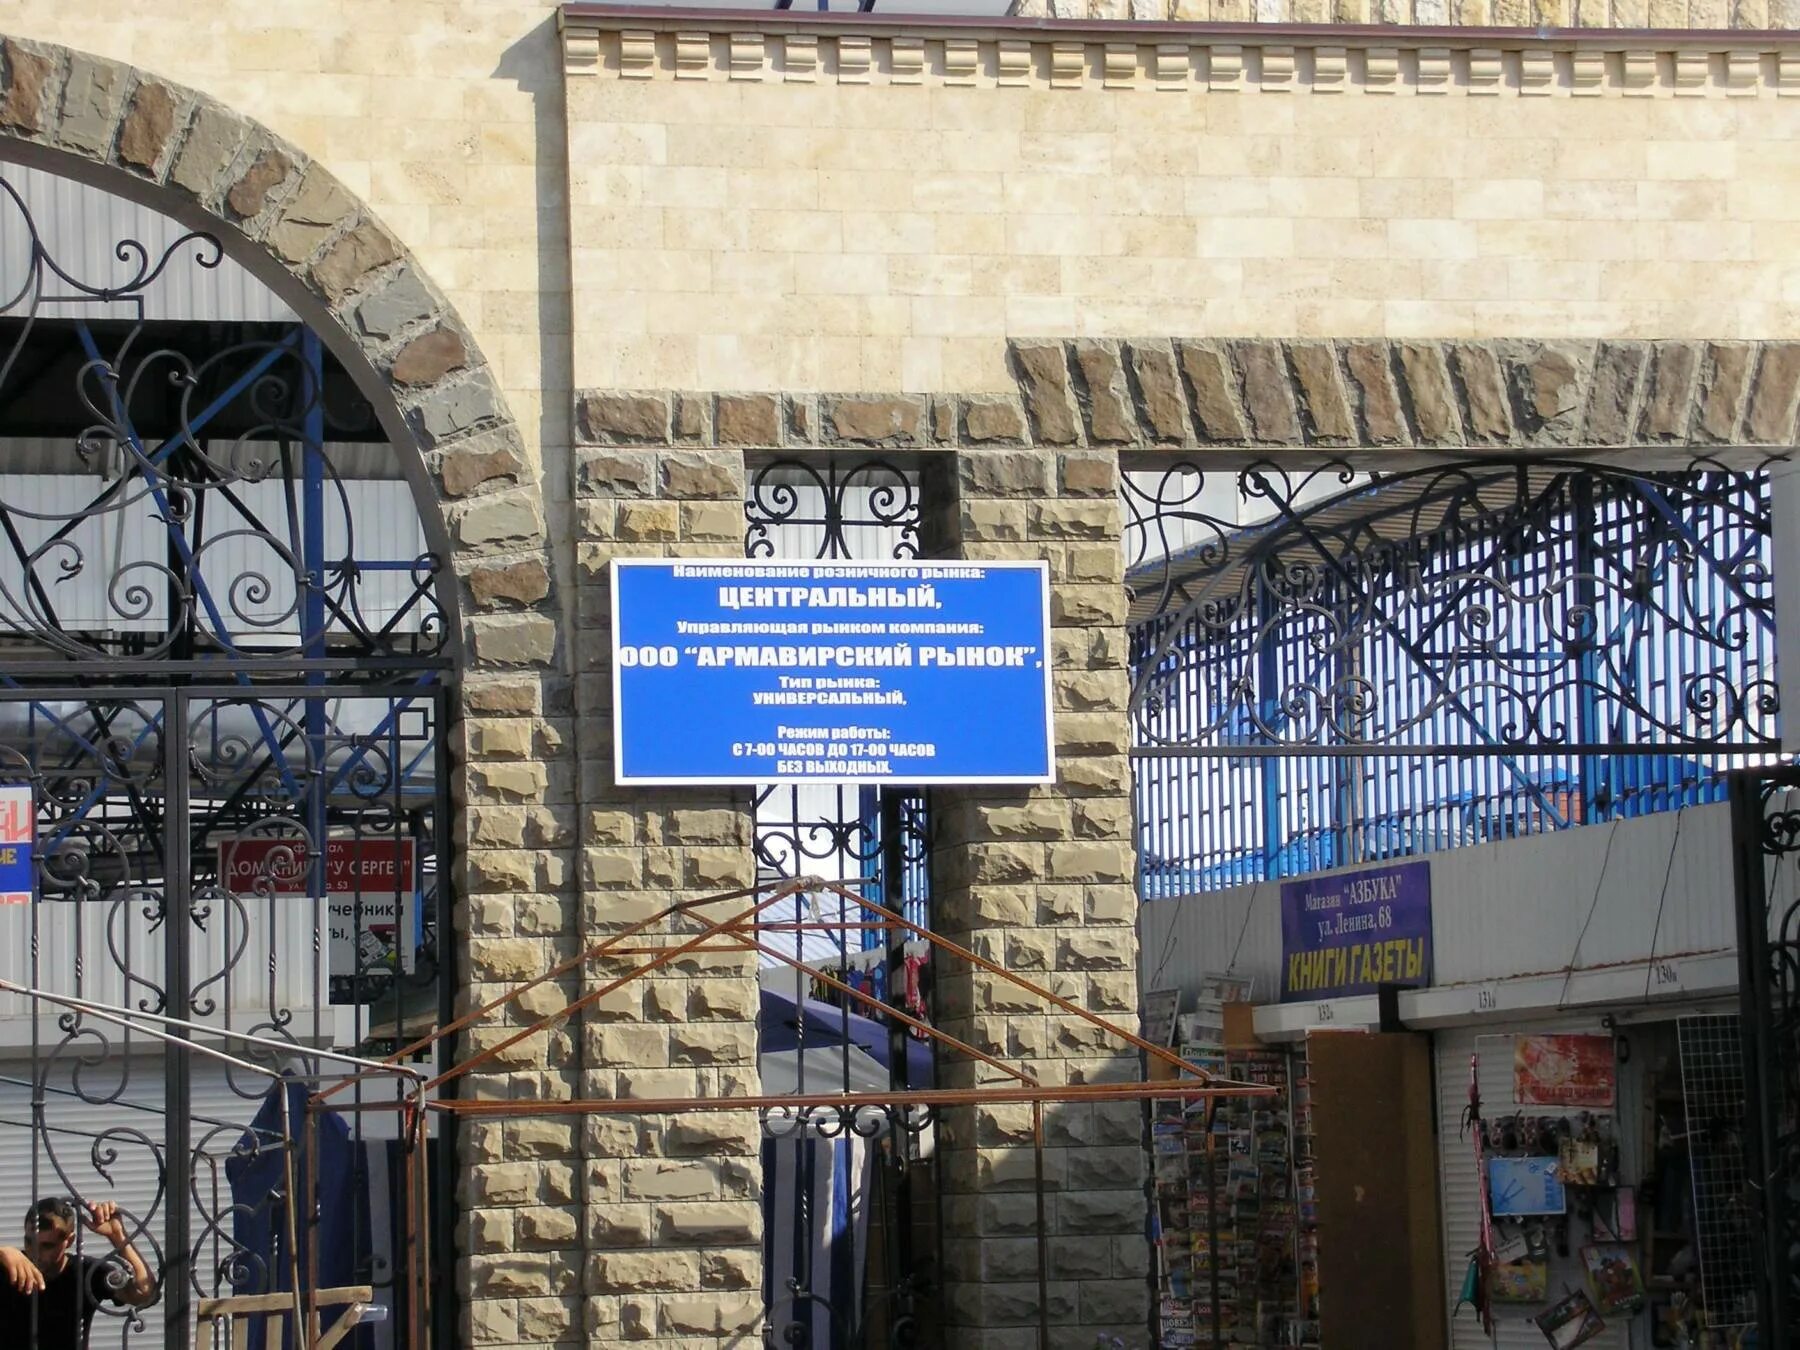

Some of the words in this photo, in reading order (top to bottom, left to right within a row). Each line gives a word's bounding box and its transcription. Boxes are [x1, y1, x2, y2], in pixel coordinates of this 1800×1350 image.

[673, 565, 809, 578] Наименование
[813, 567, 918, 580] розничного
[922, 568, 985, 580] рынка:
[719, 584, 942, 609] ЦЕНТРАЛЬНЫЙ,
[677, 621, 808, 635] Управляющая
[812, 623, 885, 635] рынком
[889, 623, 984, 635] компания:
[620, 646, 678, 667] ООО
[779, 676, 812, 689] Тип
[816, 677, 880, 690] рынка:
[753, 690, 907, 706] УНИВЕРСАЛЬНЫЙ,
[778, 726, 829, 740] Режим
[832, 726, 891, 740] работы:
[733, 743, 743, 756] С
[746, 743, 775, 756] 7-00
[778, 744, 825, 757] ЧАСОВ
[827, 744, 847, 758] ДО
[850, 744, 889, 757] 17-00
[889, 744, 935, 757] ЧАСОВ
[777, 761, 803, 774] БЕЗ
[806, 761, 893, 775] ВЫХОДНЫХ.
[227, 861, 266, 877] ДОМ
[1305, 894, 1341, 912] Магазин
[1318, 920, 1334, 942] ул.
[1335, 911, 1377, 935] Ленина,
[1378, 905, 1392, 928] 68
[1288, 946, 1347, 992] КНИГИ
[1350, 936, 1424, 984] ГАЗЕТЫ
